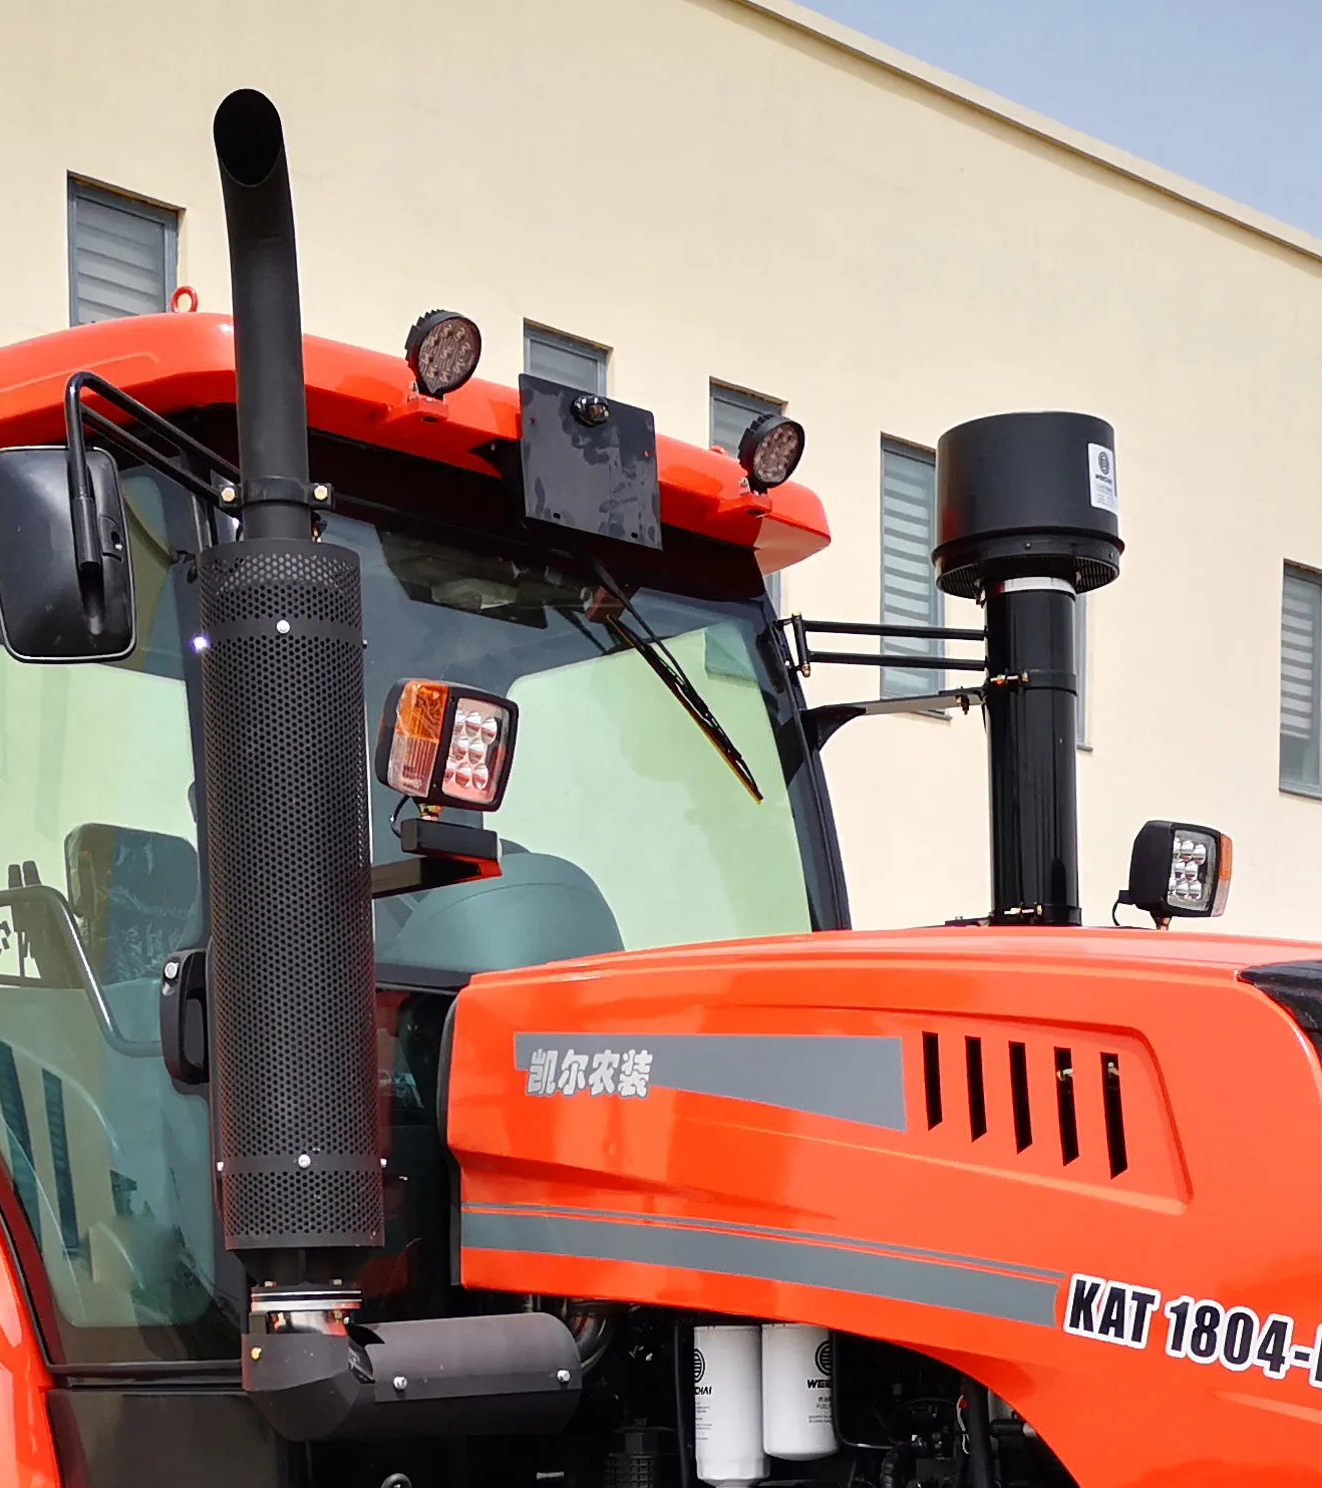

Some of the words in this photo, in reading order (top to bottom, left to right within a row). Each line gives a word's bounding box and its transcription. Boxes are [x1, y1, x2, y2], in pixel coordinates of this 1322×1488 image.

[525, 1047, 654, 1098] 凯尔农装
[1066, 1275, 1160, 1347] KAT
